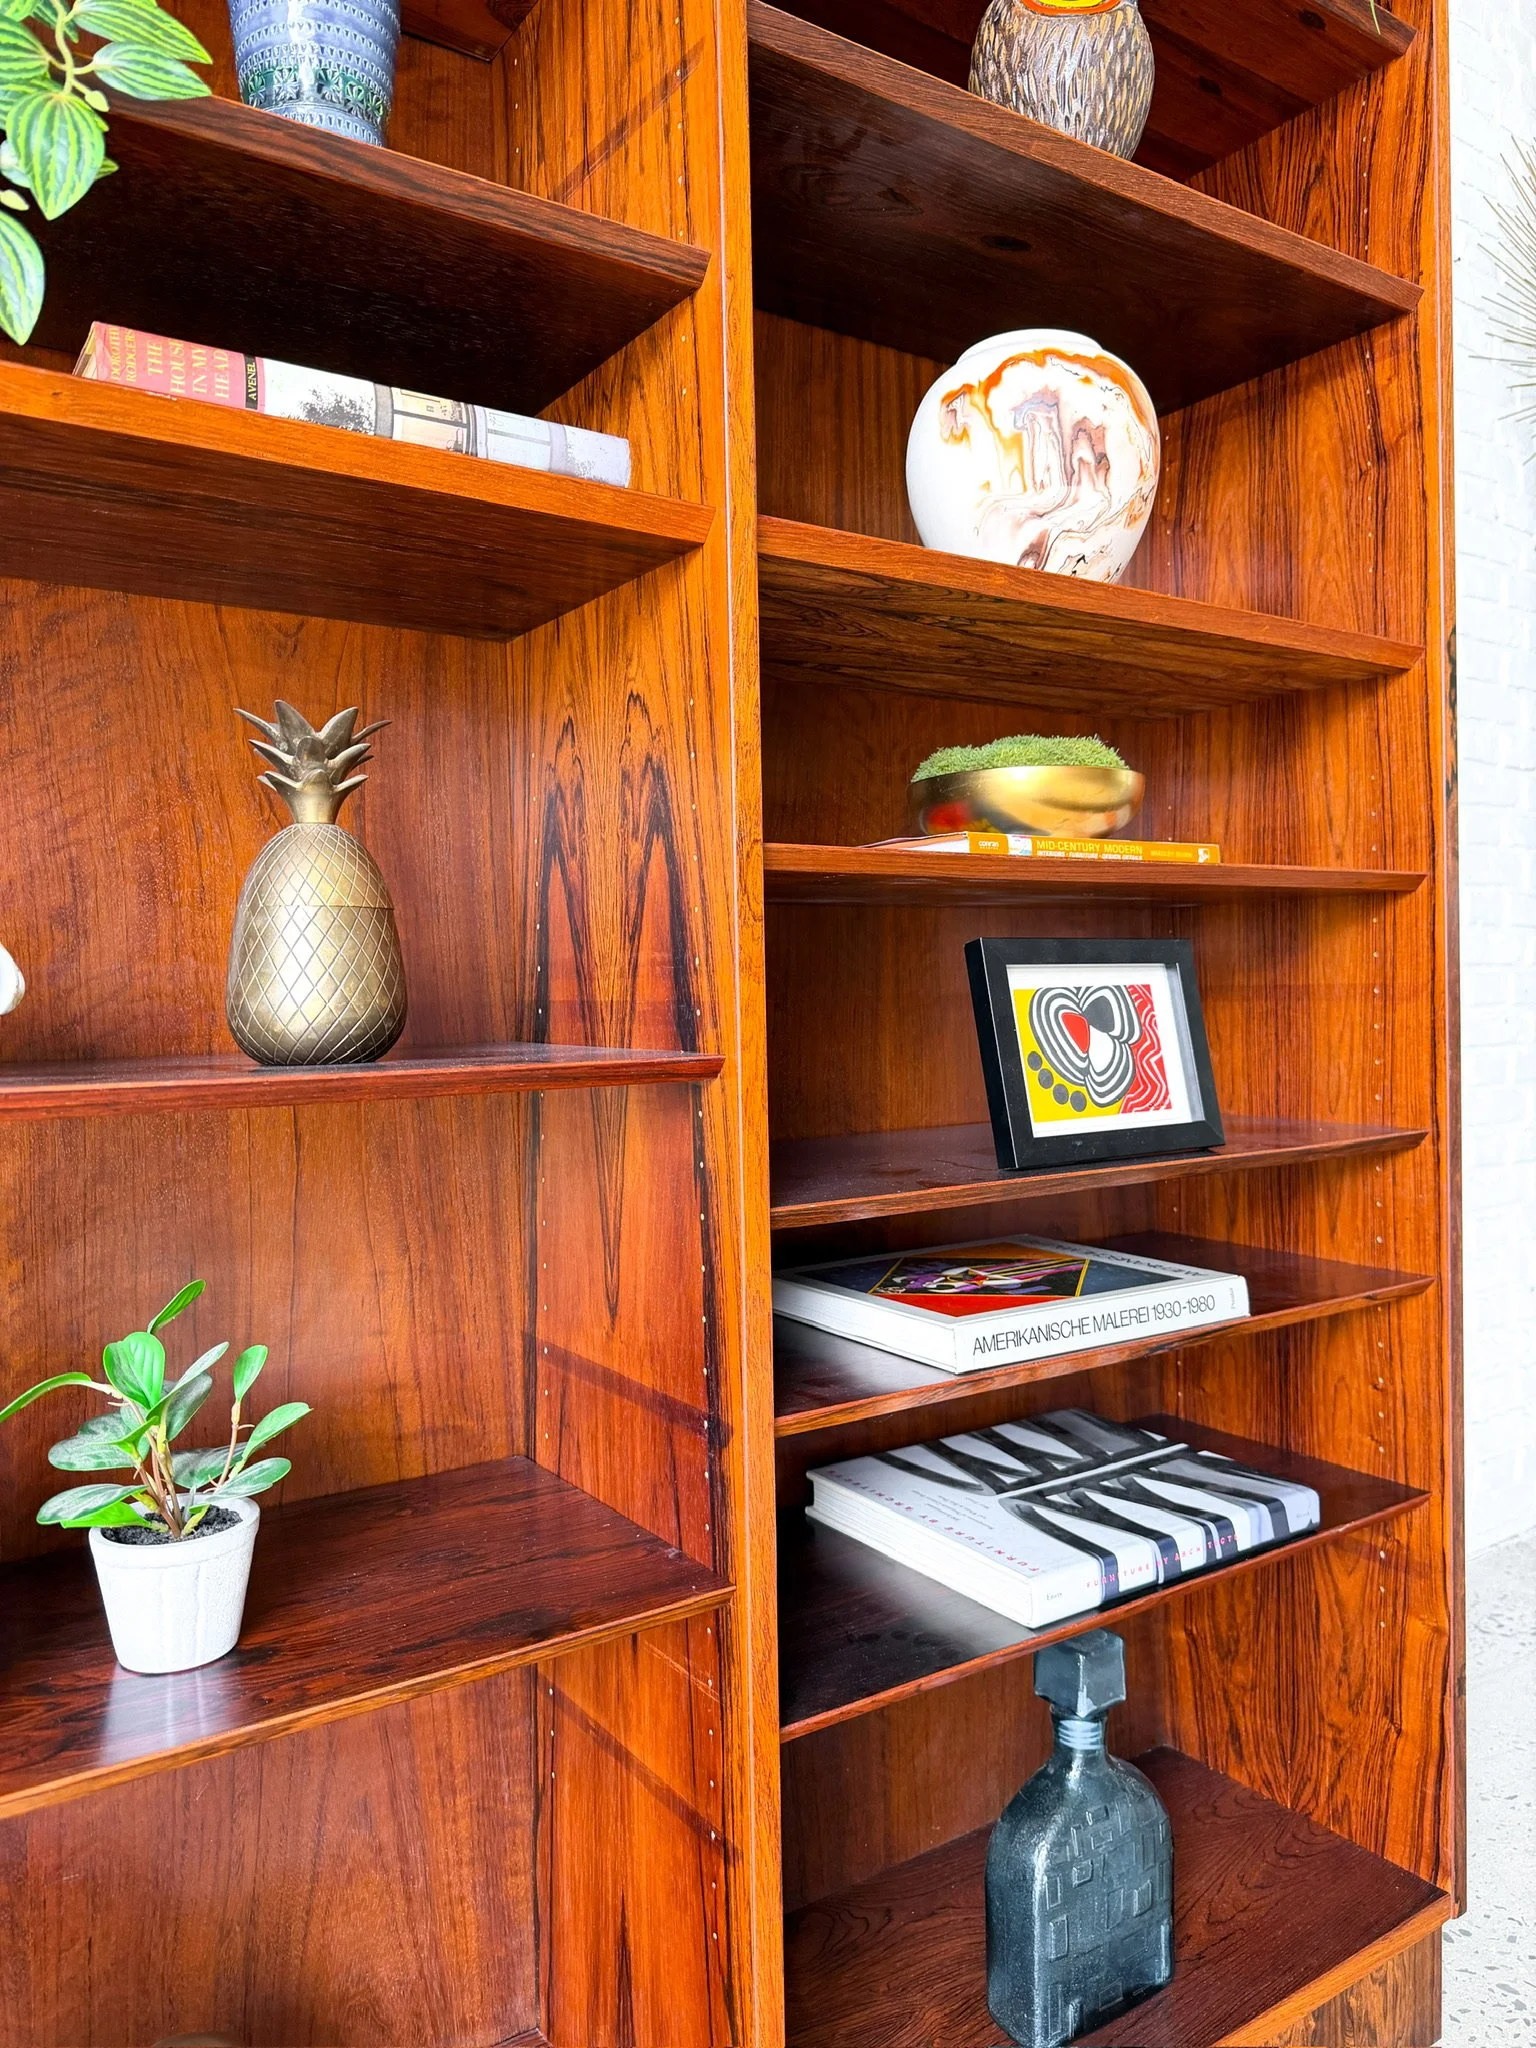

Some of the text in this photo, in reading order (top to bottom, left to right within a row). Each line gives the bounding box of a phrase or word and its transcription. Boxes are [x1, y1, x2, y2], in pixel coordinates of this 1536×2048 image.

[124, 329, 137, 382] RODGERS
[147, 341, 164, 376] THE
[191, 345, 208, 394] IN MY
[213, 350, 230, 398] HEAD
[247, 361, 257, 400] AVENEL
[1036, 840, 1143, 855] MID-CENTURY MODERN
[972, 1316, 1090, 1356] AMERIKANISCHE
[1093, 1306, 1150, 1333] MALEREI
[1152, 1294, 1216, 1321] 1930-1980
